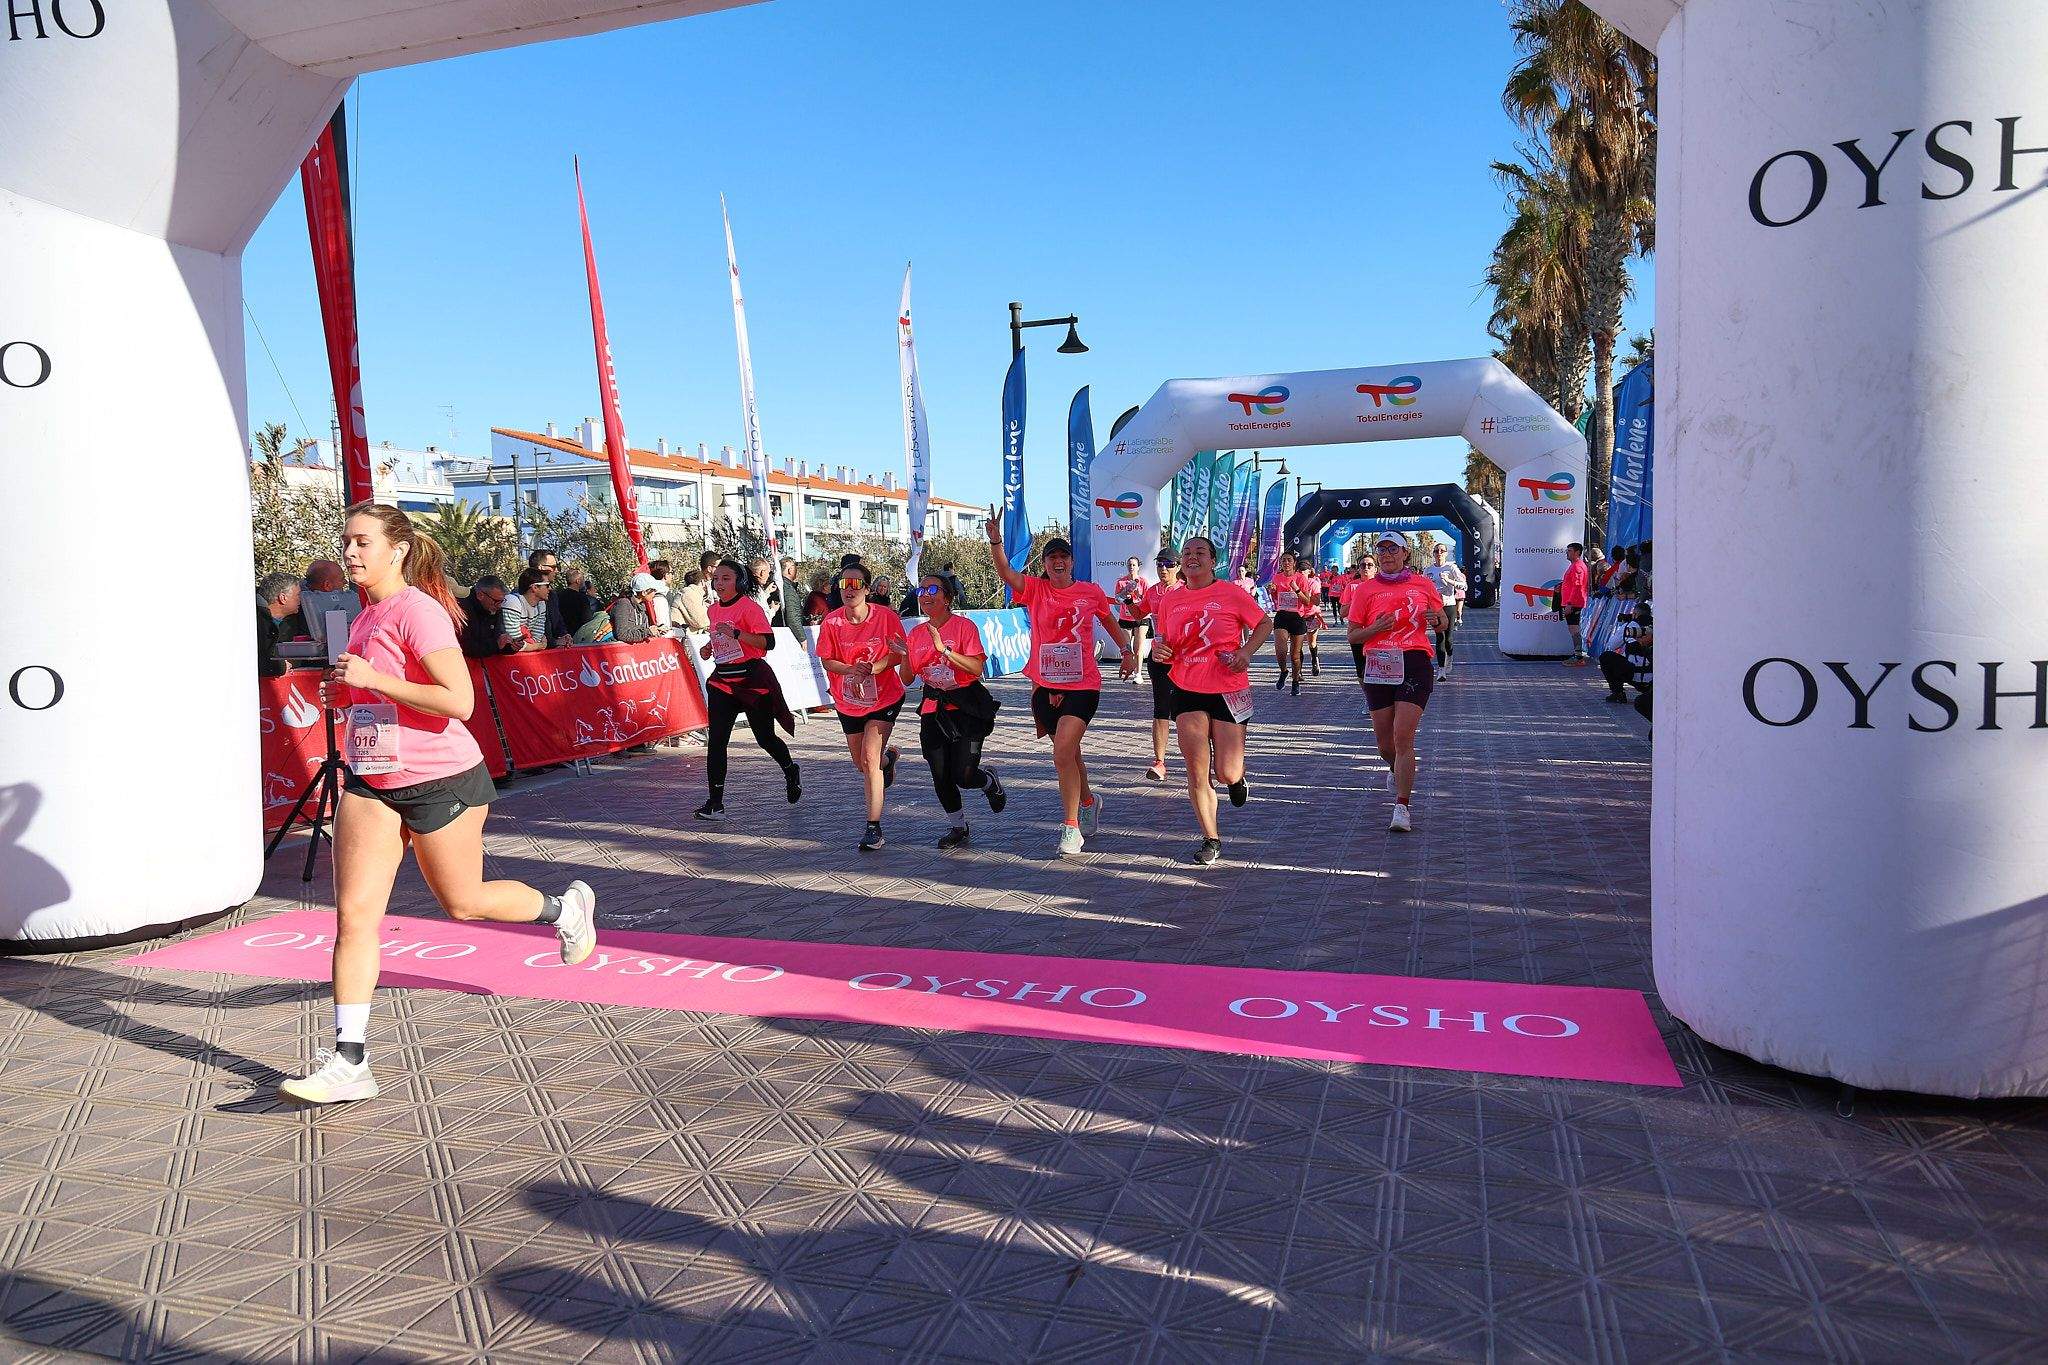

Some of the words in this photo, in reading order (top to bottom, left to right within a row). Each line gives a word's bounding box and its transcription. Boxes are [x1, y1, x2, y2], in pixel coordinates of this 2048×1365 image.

[1229, 421, 1291, 431] TotalEnergies
[1357, 411, 1423, 424] TotalEnergies
[1005, 419, 1022, 512] Marlene
[1612, 418, 1647, 505] Marlene
[1071, 442, 1091, 520] Marlene
[1338, 496, 1433, 507] VOLVO
[1516, 507, 1575, 516] TotalEnergies
[1095, 523, 1144, 532] TotalEnergies
[1512, 612, 1559, 622] TotalEnerg
[983, 613, 1031, 675] Marle
[510, 668, 578, 703] Sports
[600, 653, 680, 686] Santander
[1054, 660, 1071, 668] 016
[354, 735, 377, 747] 016
[243, 932, 477, 960] OYHO
[523, 951, 785, 983] OYSHO
[848, 972, 1147, 1008] OYSHO
[1228, 997, 1580, 1038] OYSHO
